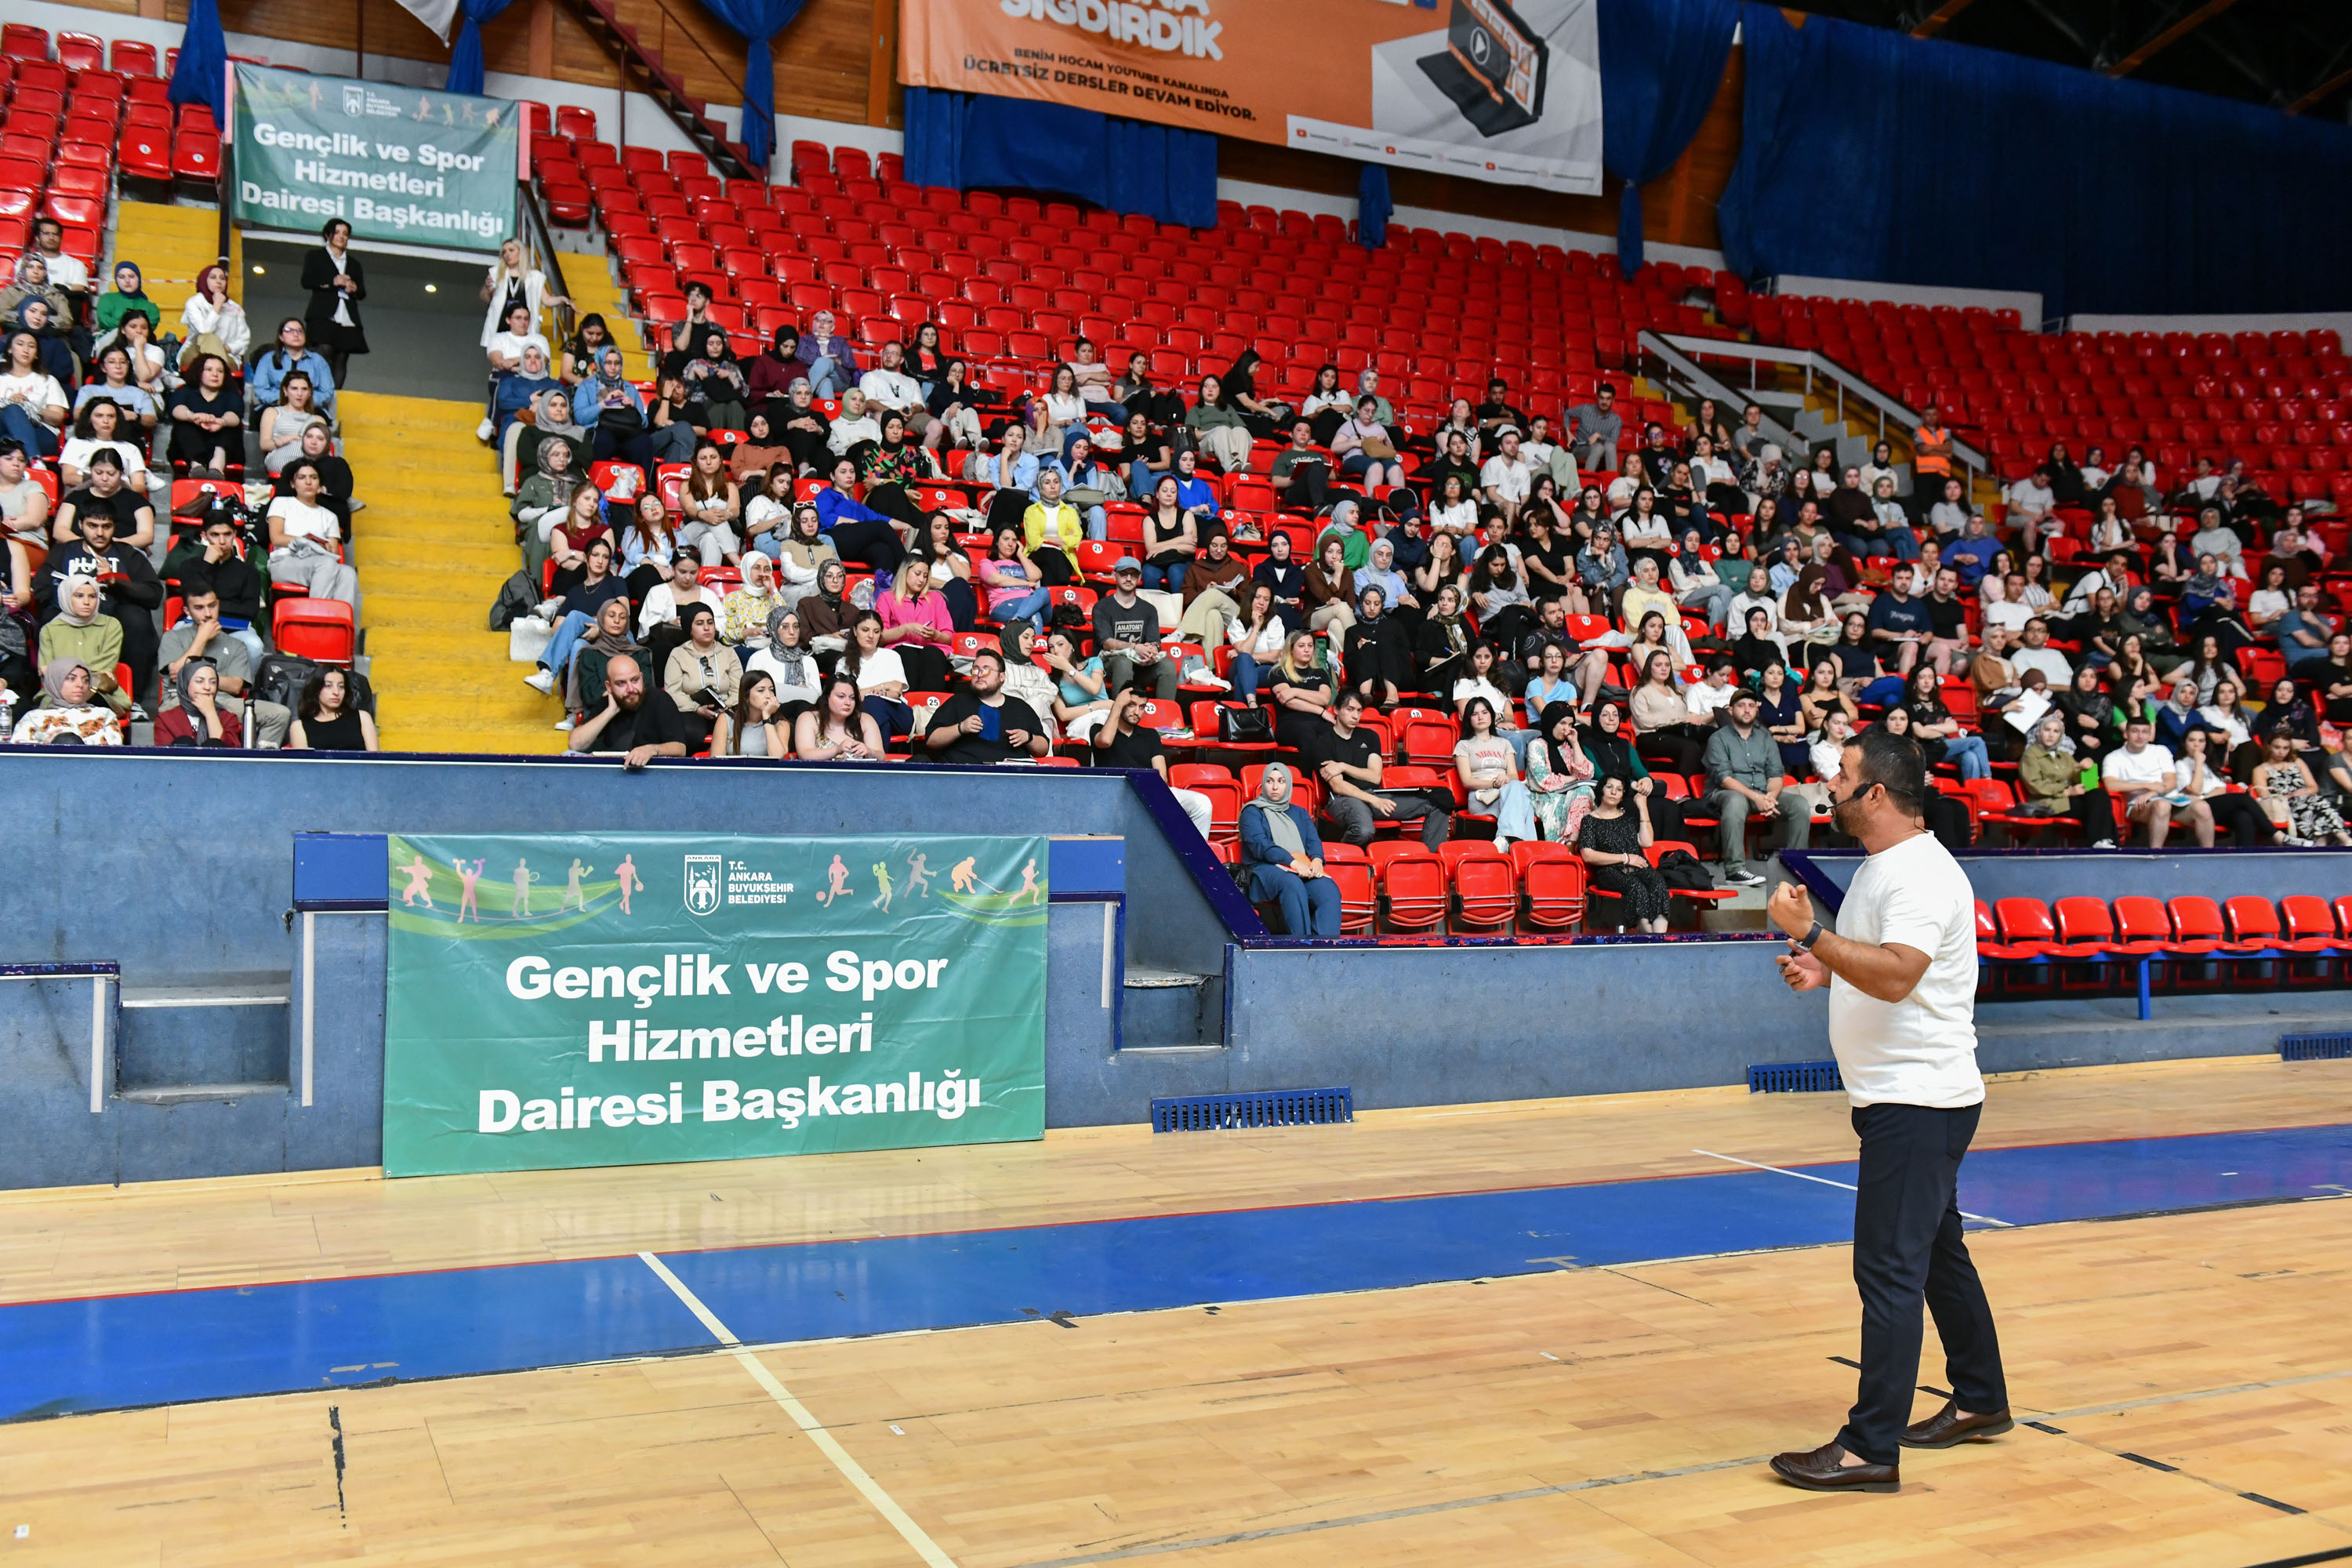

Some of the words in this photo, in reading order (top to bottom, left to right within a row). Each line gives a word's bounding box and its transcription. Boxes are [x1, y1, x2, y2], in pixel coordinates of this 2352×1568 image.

[964, 54, 1049, 81] ÜCRETSİZ
[1054, 69, 1128, 95] DERSLER
[1133, 85, 1192, 107] DEVAM
[1195, 98, 1257, 122] EDİYOR.
[1014, 47, 1055, 62] BENİM
[1058, 53, 1104, 71] HOCAM
[1106, 63, 1160, 83] YOUTUBE
[1163, 77, 1229, 99] KANALINDA
[253, 122, 368, 158] Gençlik
[375, 141, 410, 163] ve
[417, 143, 485, 173] Spor
[295, 158, 444, 199] Hizmetleri
[242, 180, 345, 217] Dairesi
[354, 197, 503, 238] Başkanlığı
[728, 861, 747, 870] T.C.
[728, 872, 773, 882] ANKARA
[506, 954, 731, 1009] Gençlik
[745, 963, 809, 994] ve
[825, 950, 949, 1001] Spor
[588, 1012, 873, 1062] Hizmetleri
[478, 1082, 683, 1133] Dairesi
[702, 1069, 981, 1130] Başkanlığı
